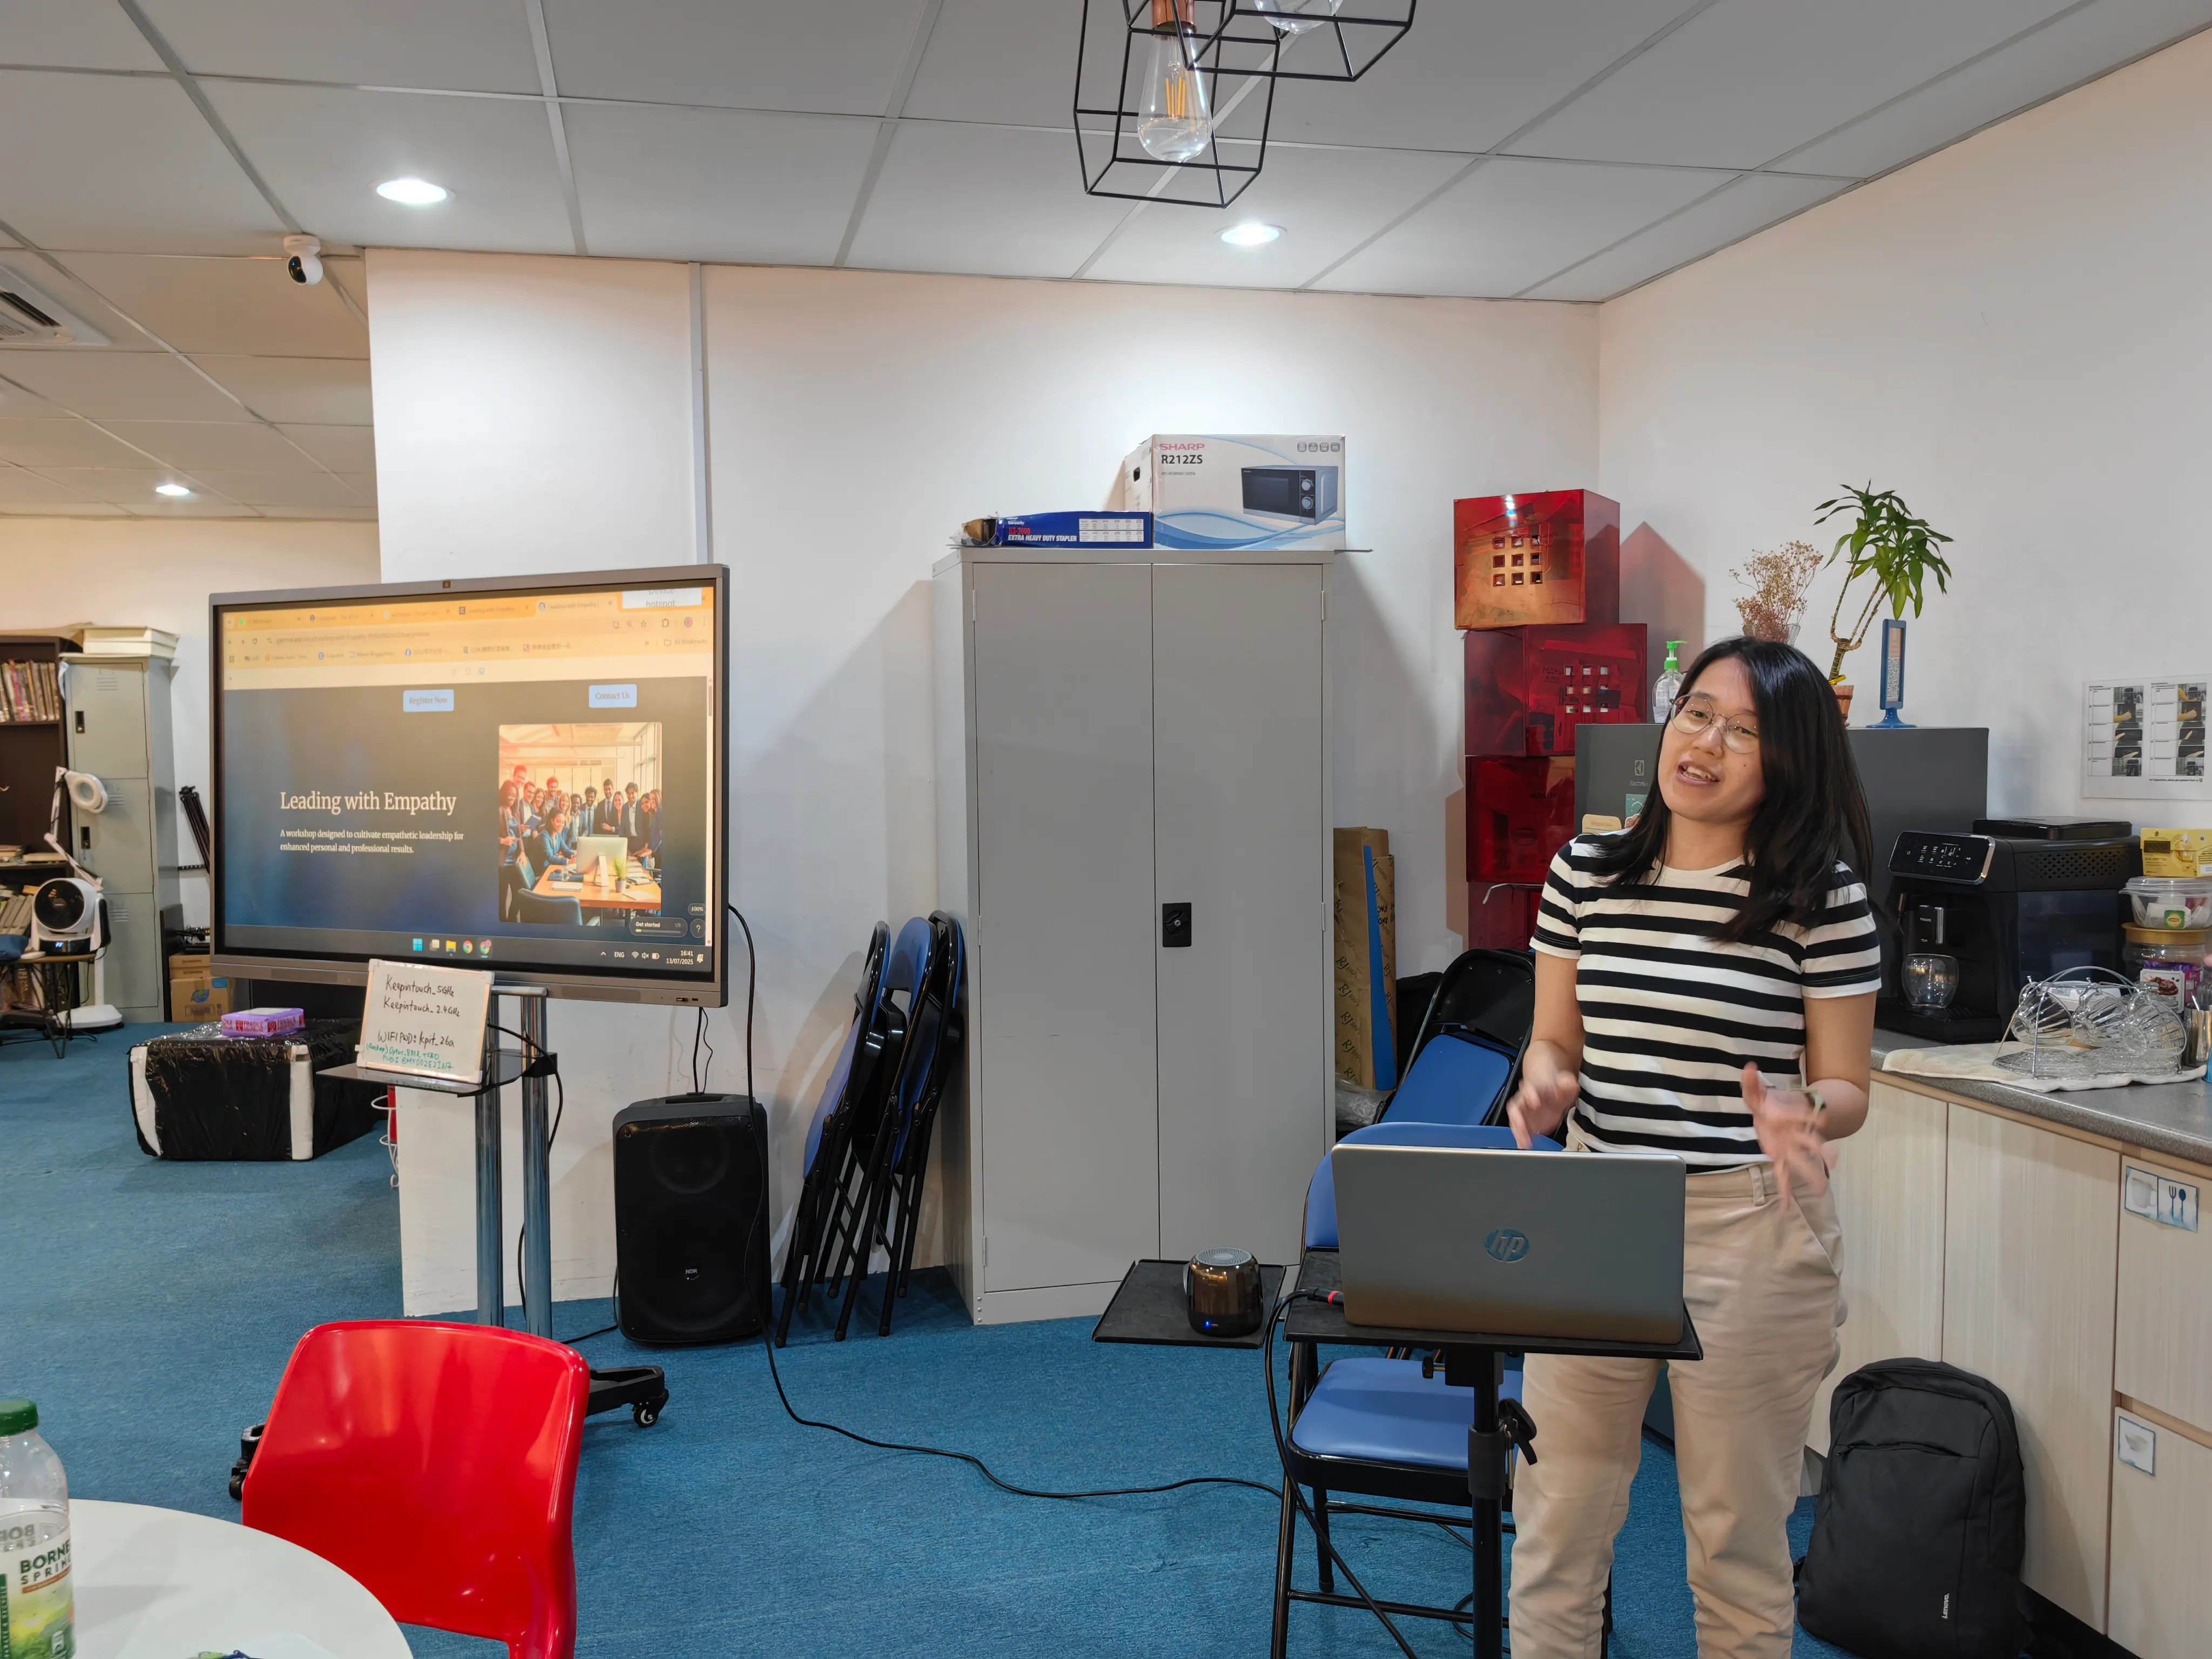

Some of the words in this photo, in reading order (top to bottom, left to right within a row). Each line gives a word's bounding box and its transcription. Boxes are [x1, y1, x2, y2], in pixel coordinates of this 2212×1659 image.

[1161, 454, 1203, 464] R212ZS
[409, 696, 433, 706] Register
[434, 696, 448, 704] Now
[595, 692, 621, 700] Contact
[622, 692, 630, 700] Us
[280, 791, 341, 815] Leading
[345, 791, 380, 810] with
[384, 791, 456, 815] Empathy
[280, 829, 286, 837] A
[286, 829, 316, 840] workshop
[318, 829, 346, 840] designed
[354, 830, 381, 839] cultivate
[382, 831, 418, 841] empathetic
[419, 831, 453, 841] leadership
[454, 831, 464, 840] for
[280, 843, 309, 851] enhanced
[311, 844, 337, 853] personal
[338, 844, 350, 852] and
[352, 844, 389, 854] professional
[390, 845, 414, 853] results.
[696, 925, 701, 933] ?
[1488, 1228, 1526, 1263] hp
[20, 1540, 70, 1574] BORNE
[1941, 1593, 1950, 1619] Lenovo
